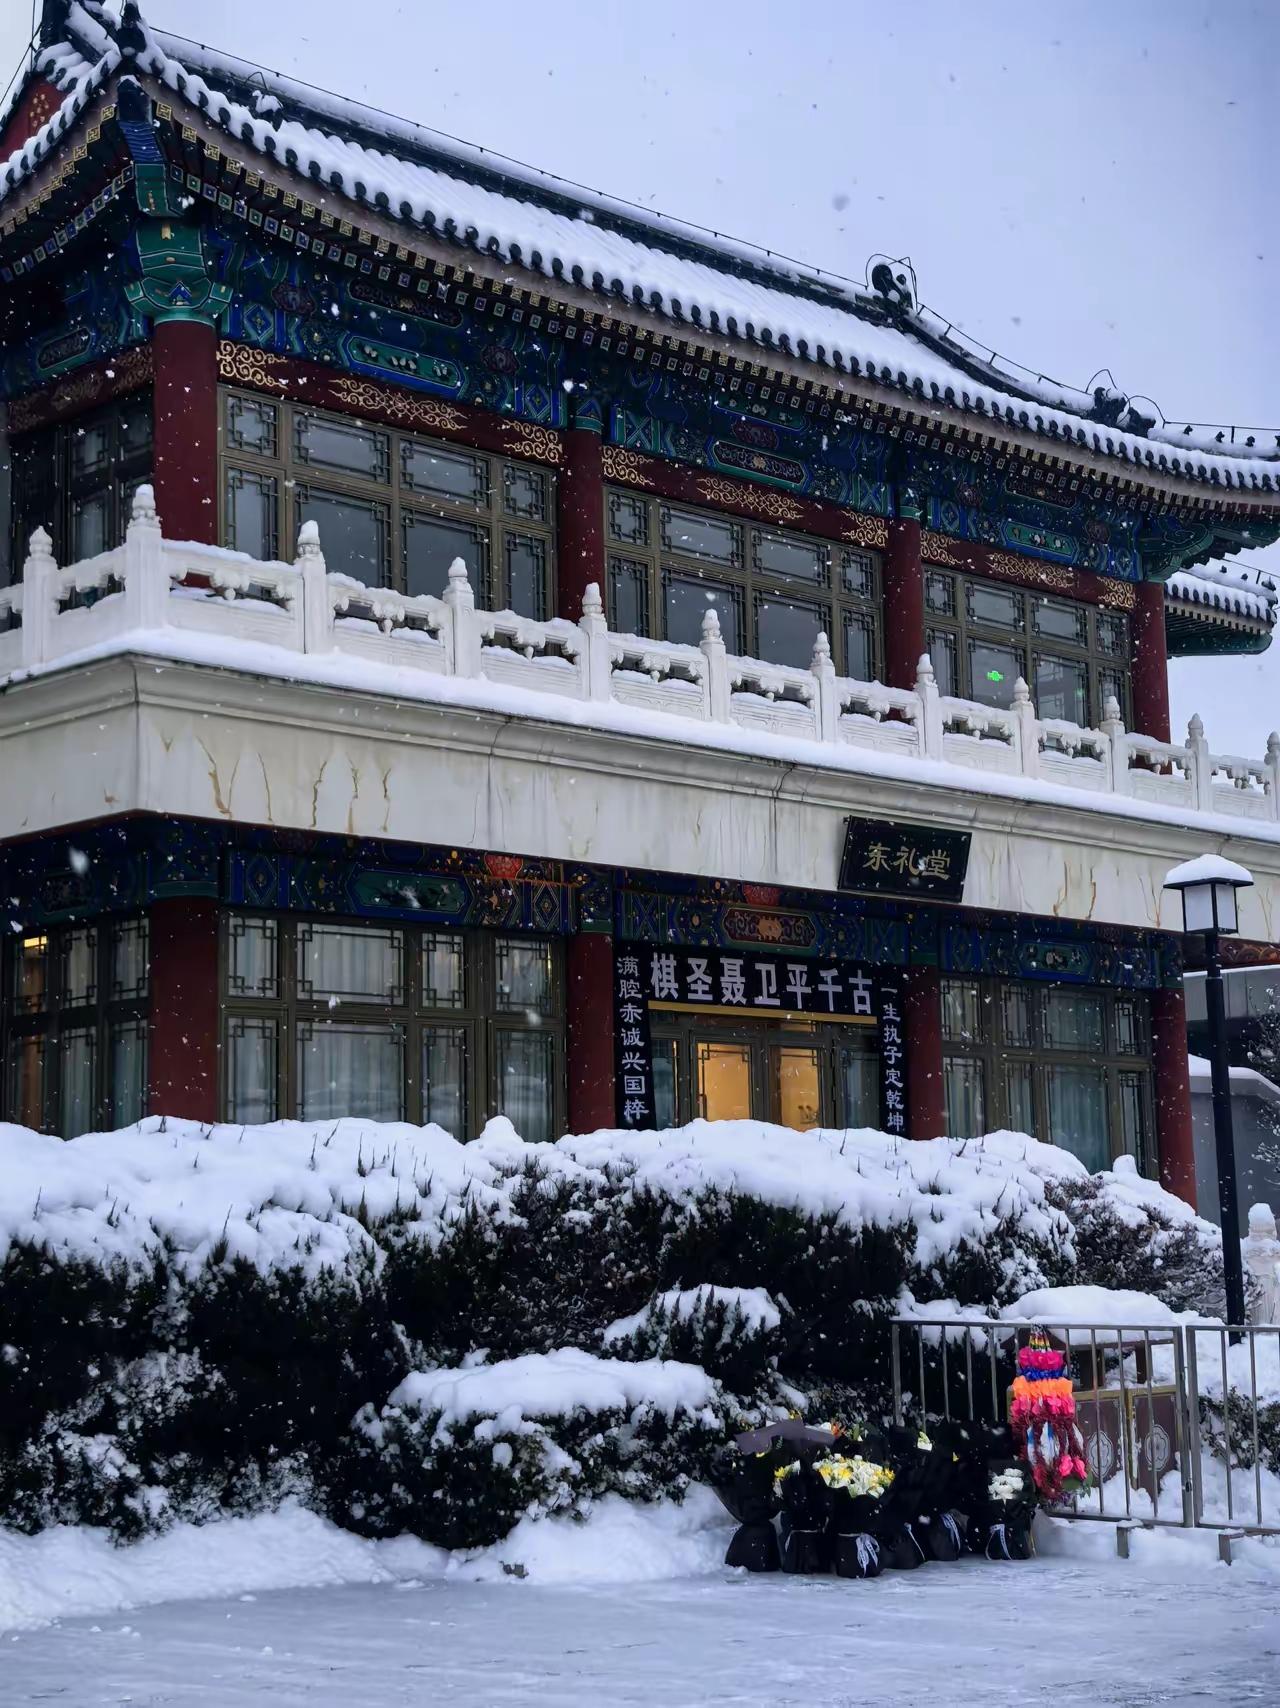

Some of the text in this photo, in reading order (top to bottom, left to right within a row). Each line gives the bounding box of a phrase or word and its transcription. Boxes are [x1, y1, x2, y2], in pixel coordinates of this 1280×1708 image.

[862, 842, 951, 880] 东礼堂
[651, 952, 873, 1014] 棋圣聂卫平千古
[617, 957, 649, 1120] 满腔赤诚兴国粹
[881, 987, 905, 1131] 一生执子定乾坤
